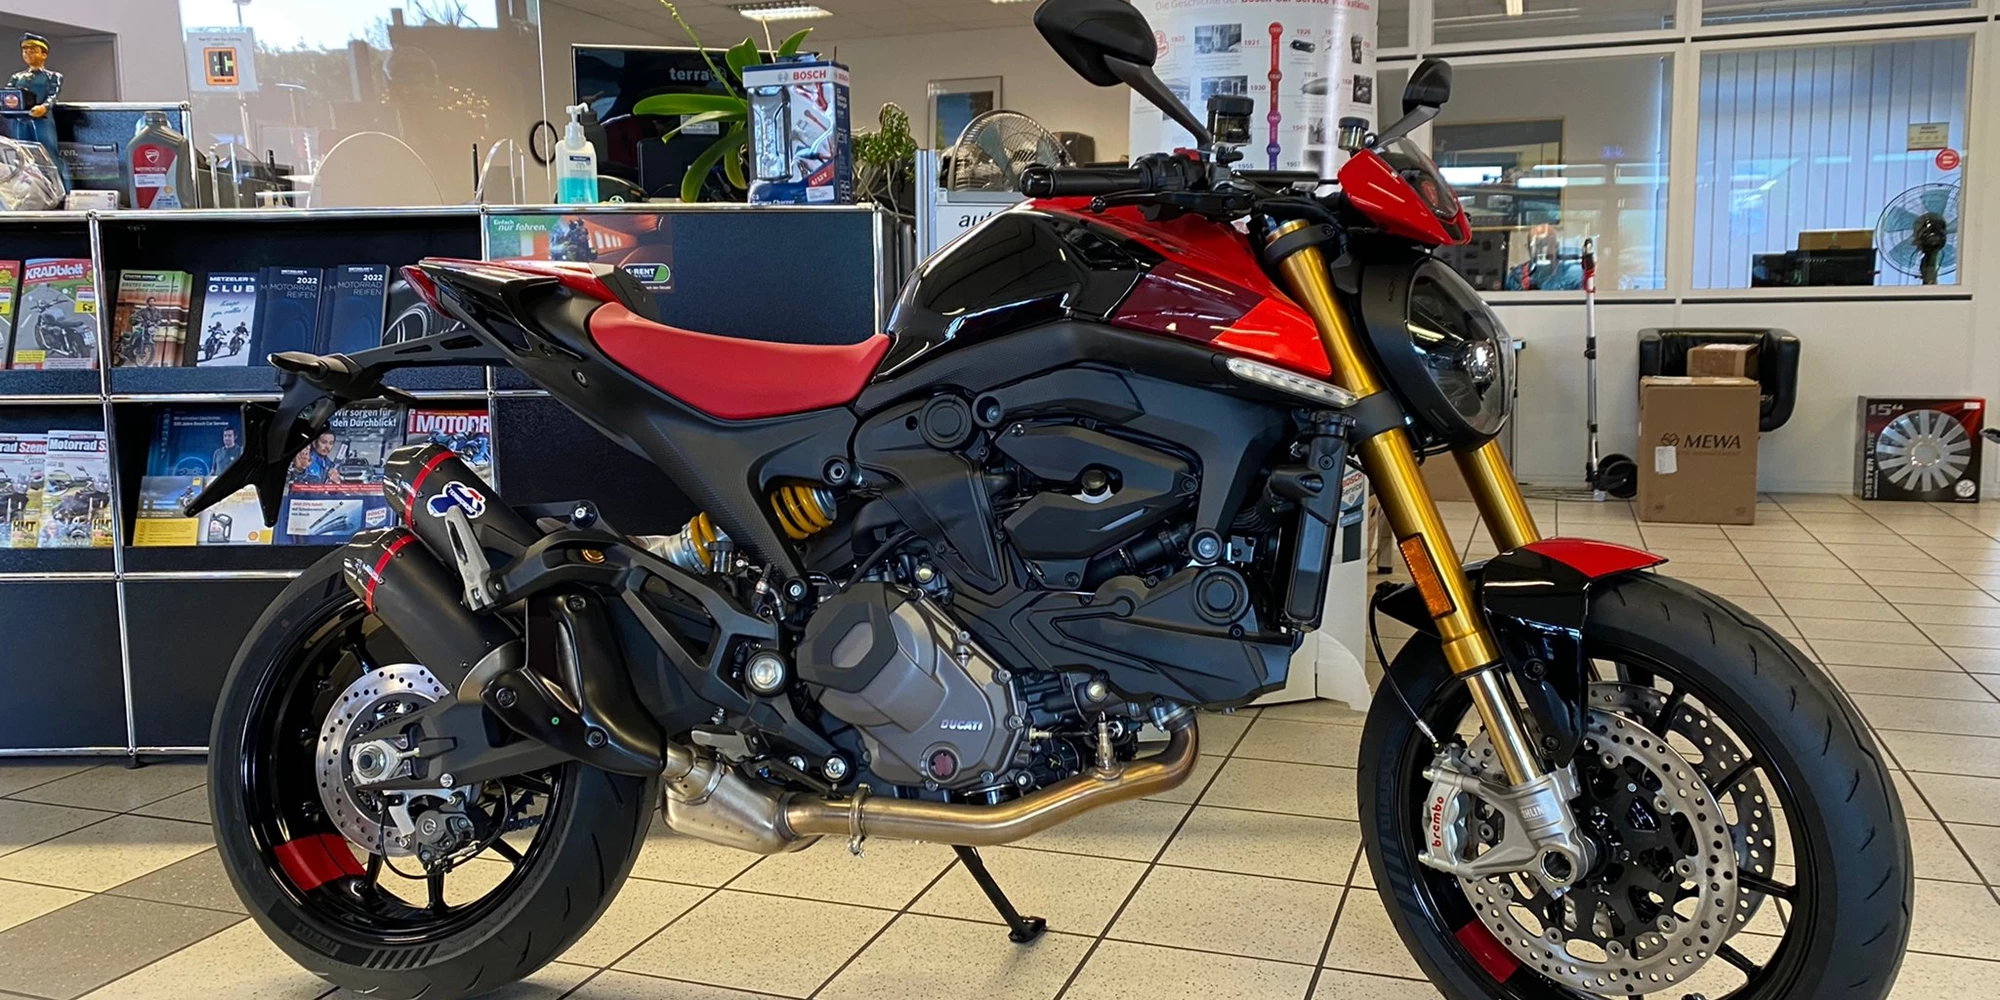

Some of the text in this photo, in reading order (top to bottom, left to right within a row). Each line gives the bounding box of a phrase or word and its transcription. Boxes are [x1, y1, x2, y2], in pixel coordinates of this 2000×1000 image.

[669, 67, 710, 81] terra
[793, 70, 826, 80] BOSCH
[515, 223, 547, 231] fahren.
[25, 264, 83, 280] KRADblatt
[338, 281, 382, 289] MOTORRAD
[286, 291, 316, 299] REIFEN
[380, 407, 391, 416] für
[332, 418, 397, 427] den Durchblick!
[49, 439, 97, 450] Motorrad
[1684, 434, 1741, 449] MEWA
[1867, 430, 1876, 454] LINE
[940, 719, 983, 731] DUCATI
[1431, 796, 1444, 848] brembo
